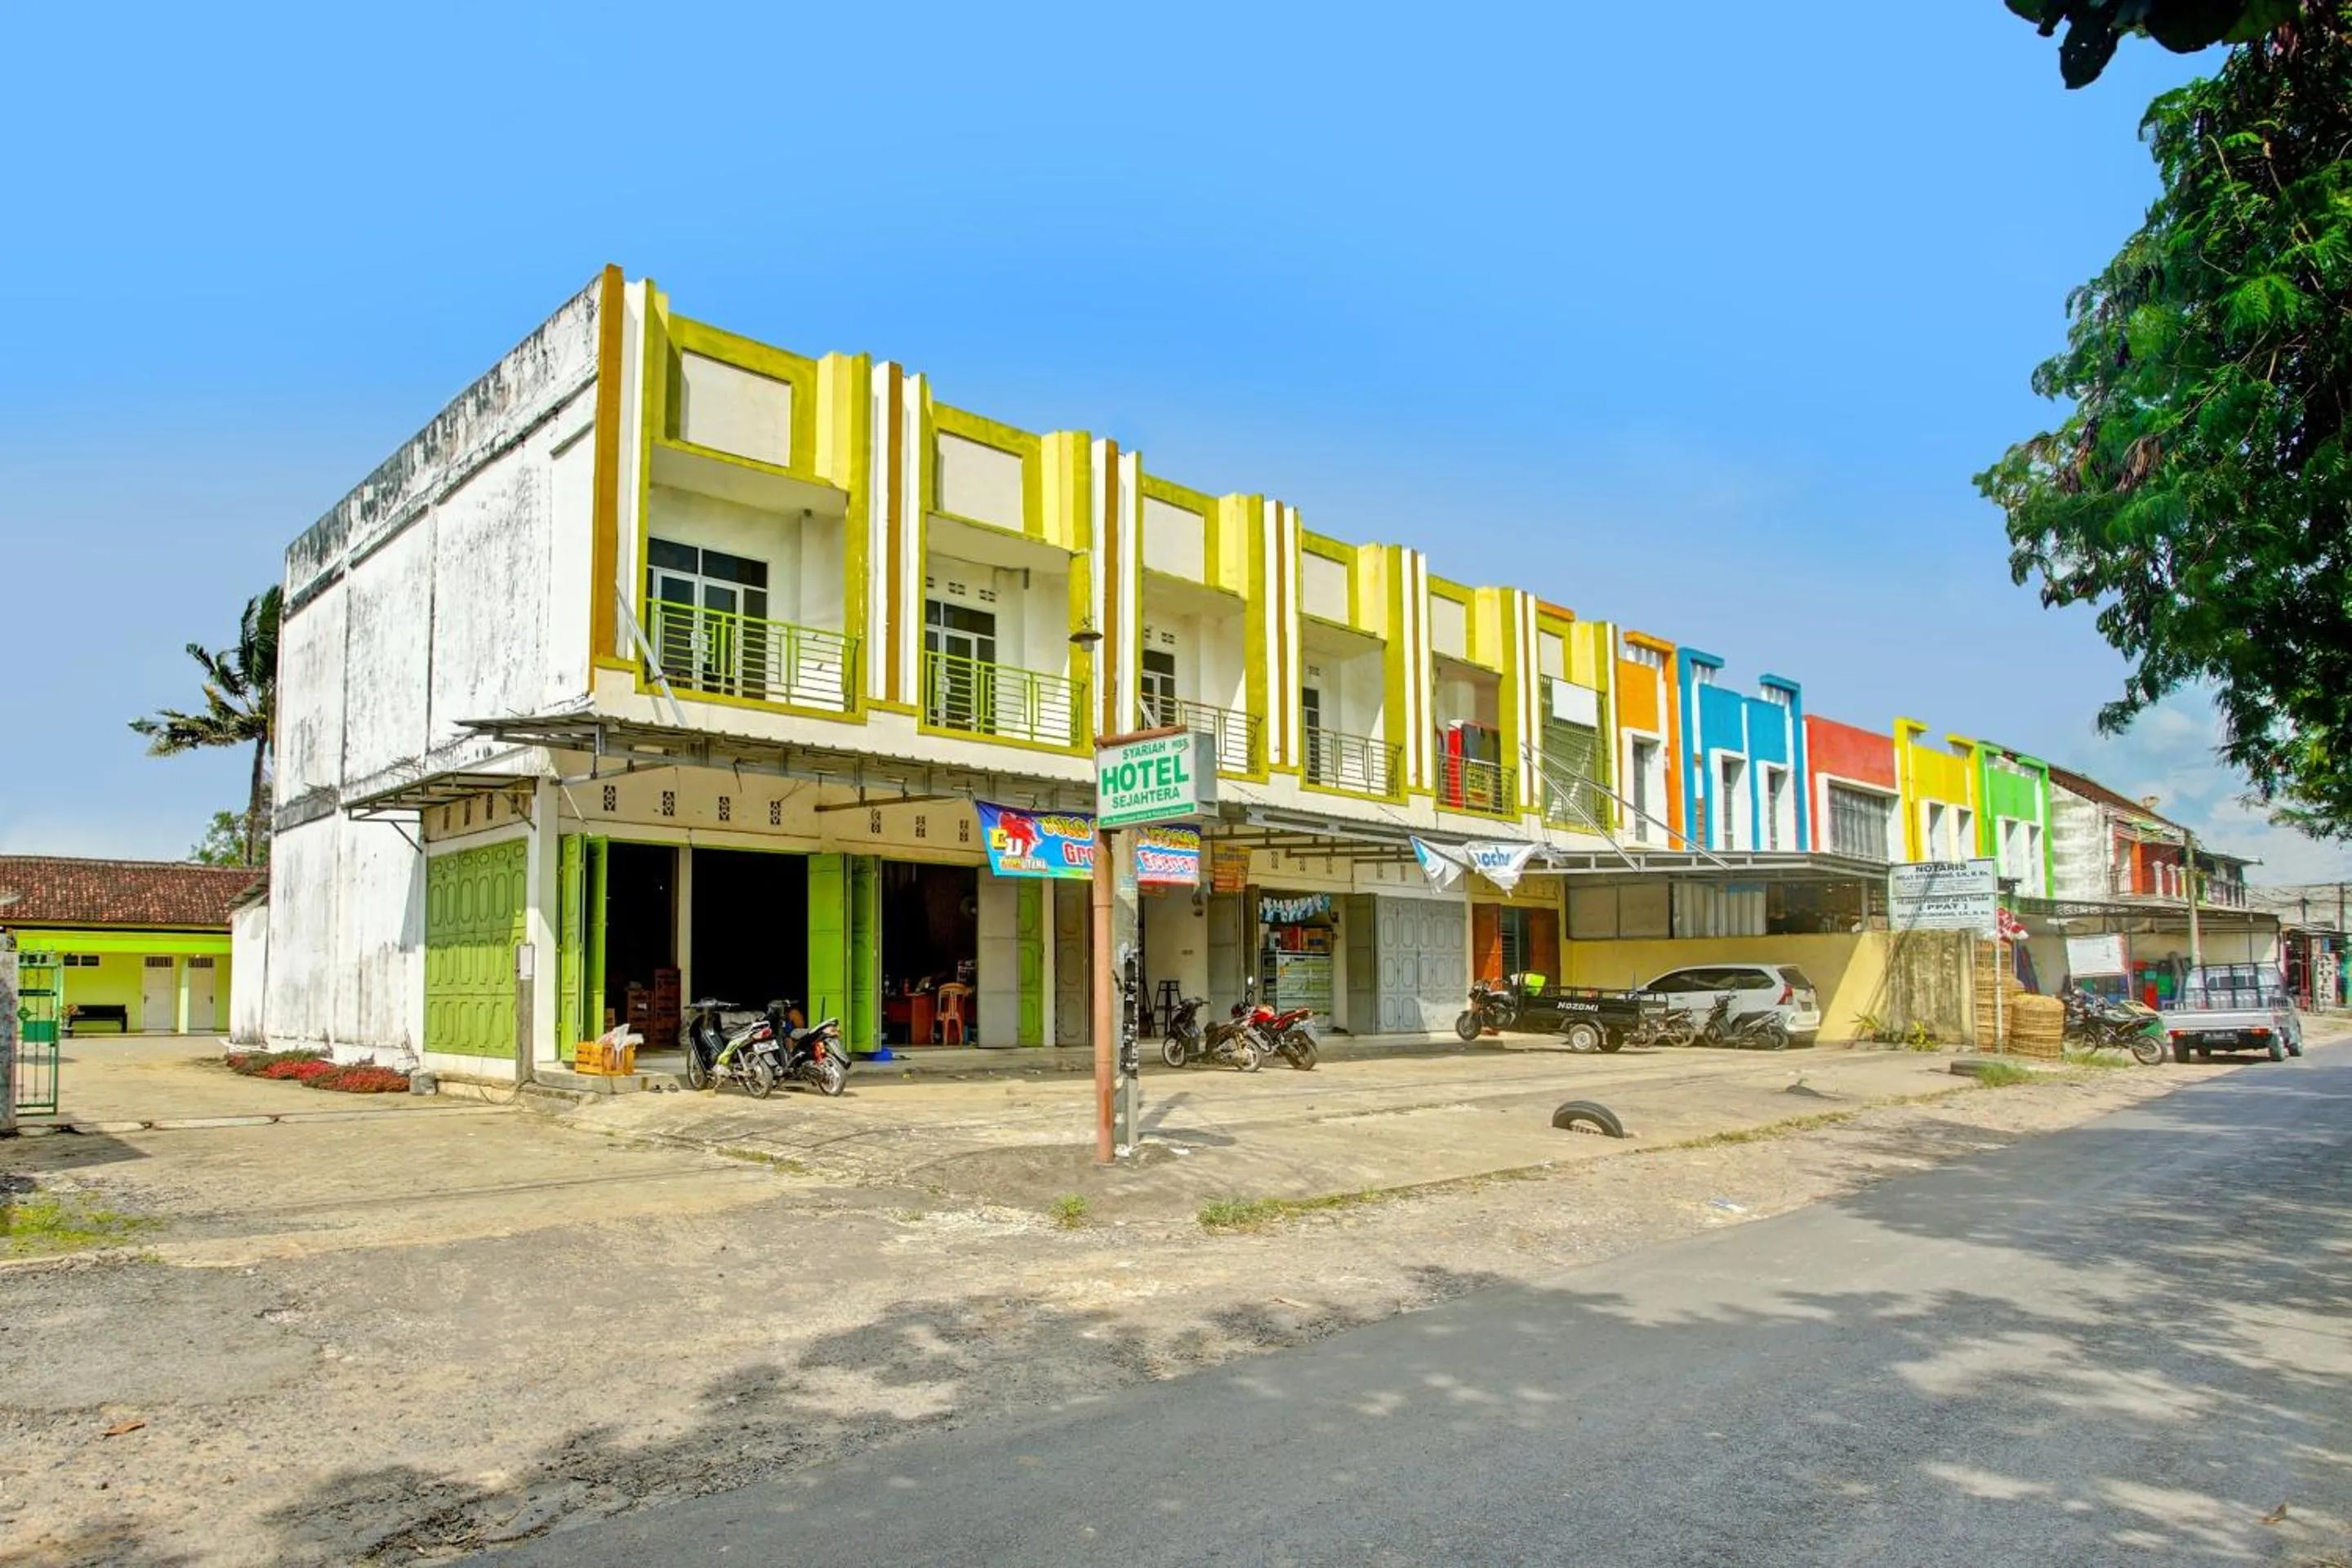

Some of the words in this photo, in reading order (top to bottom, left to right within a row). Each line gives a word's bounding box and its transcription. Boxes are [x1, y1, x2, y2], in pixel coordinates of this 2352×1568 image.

[1122, 742, 1165, 760] SYARIAH
[1102, 755, 1189, 796] HOTEL
[1112, 787, 1180, 808] SEJAHTERA
[1915, 863, 1967, 872] NOTARIS
[1557, 1001, 1599, 1013] NOZOMI
